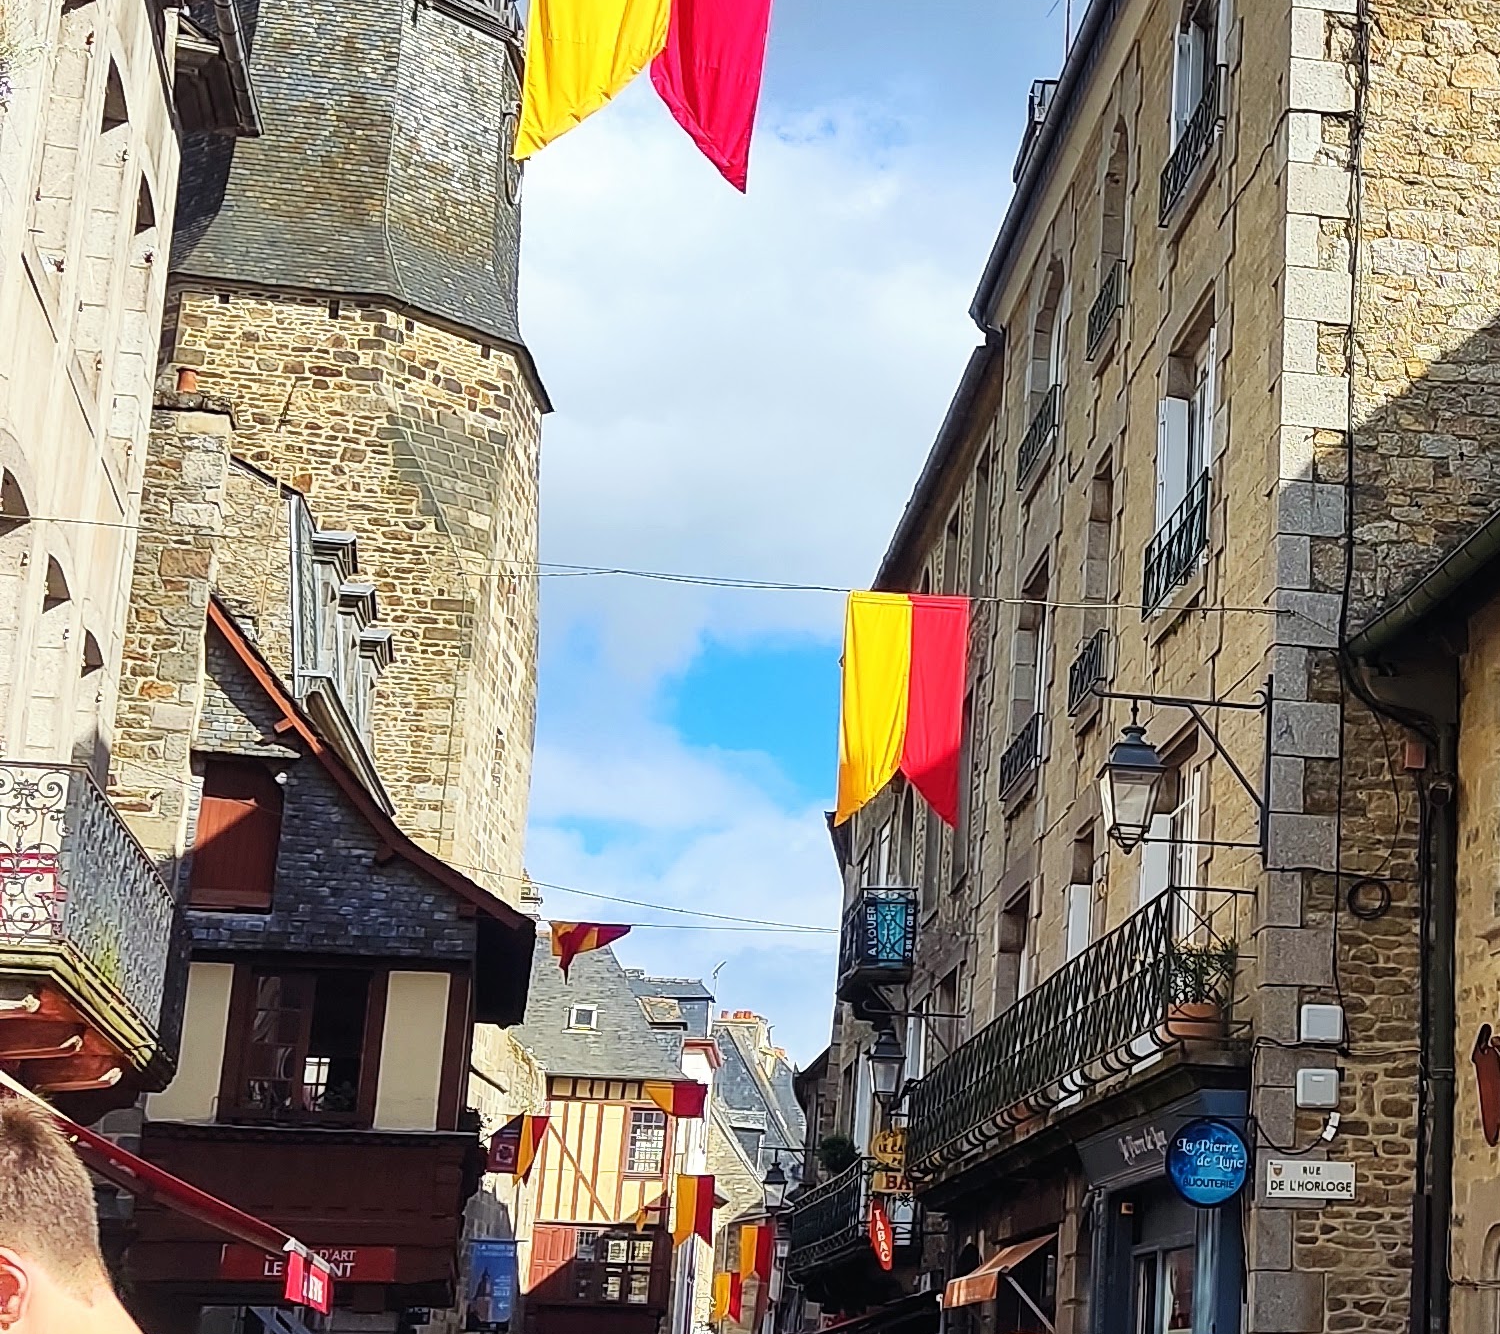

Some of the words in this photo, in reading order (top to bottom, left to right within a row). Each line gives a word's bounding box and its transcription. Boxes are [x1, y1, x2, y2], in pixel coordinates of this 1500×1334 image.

[866, 906, 878, 945] LOUER
[890, 1144, 904, 1153] CA
[1176, 1138, 1195, 1156] La
[1196, 1138, 1239, 1155] Pierre
[1196, 1155, 1212, 1168] de
[1213, 1155, 1245, 1171] Lune
[1302, 1166, 1321, 1176] RUE
[884, 1174, 911, 1190] BA
[1182, 1178, 1235, 1189] BIJOUTERIE
[1270, 1180, 1285, 1191] DE
[1289, 1180, 1352, 1193] L'HORLOGE
[873, 1209, 891, 1262] TABAC
[319, 1248, 357, 1262] D'ART
